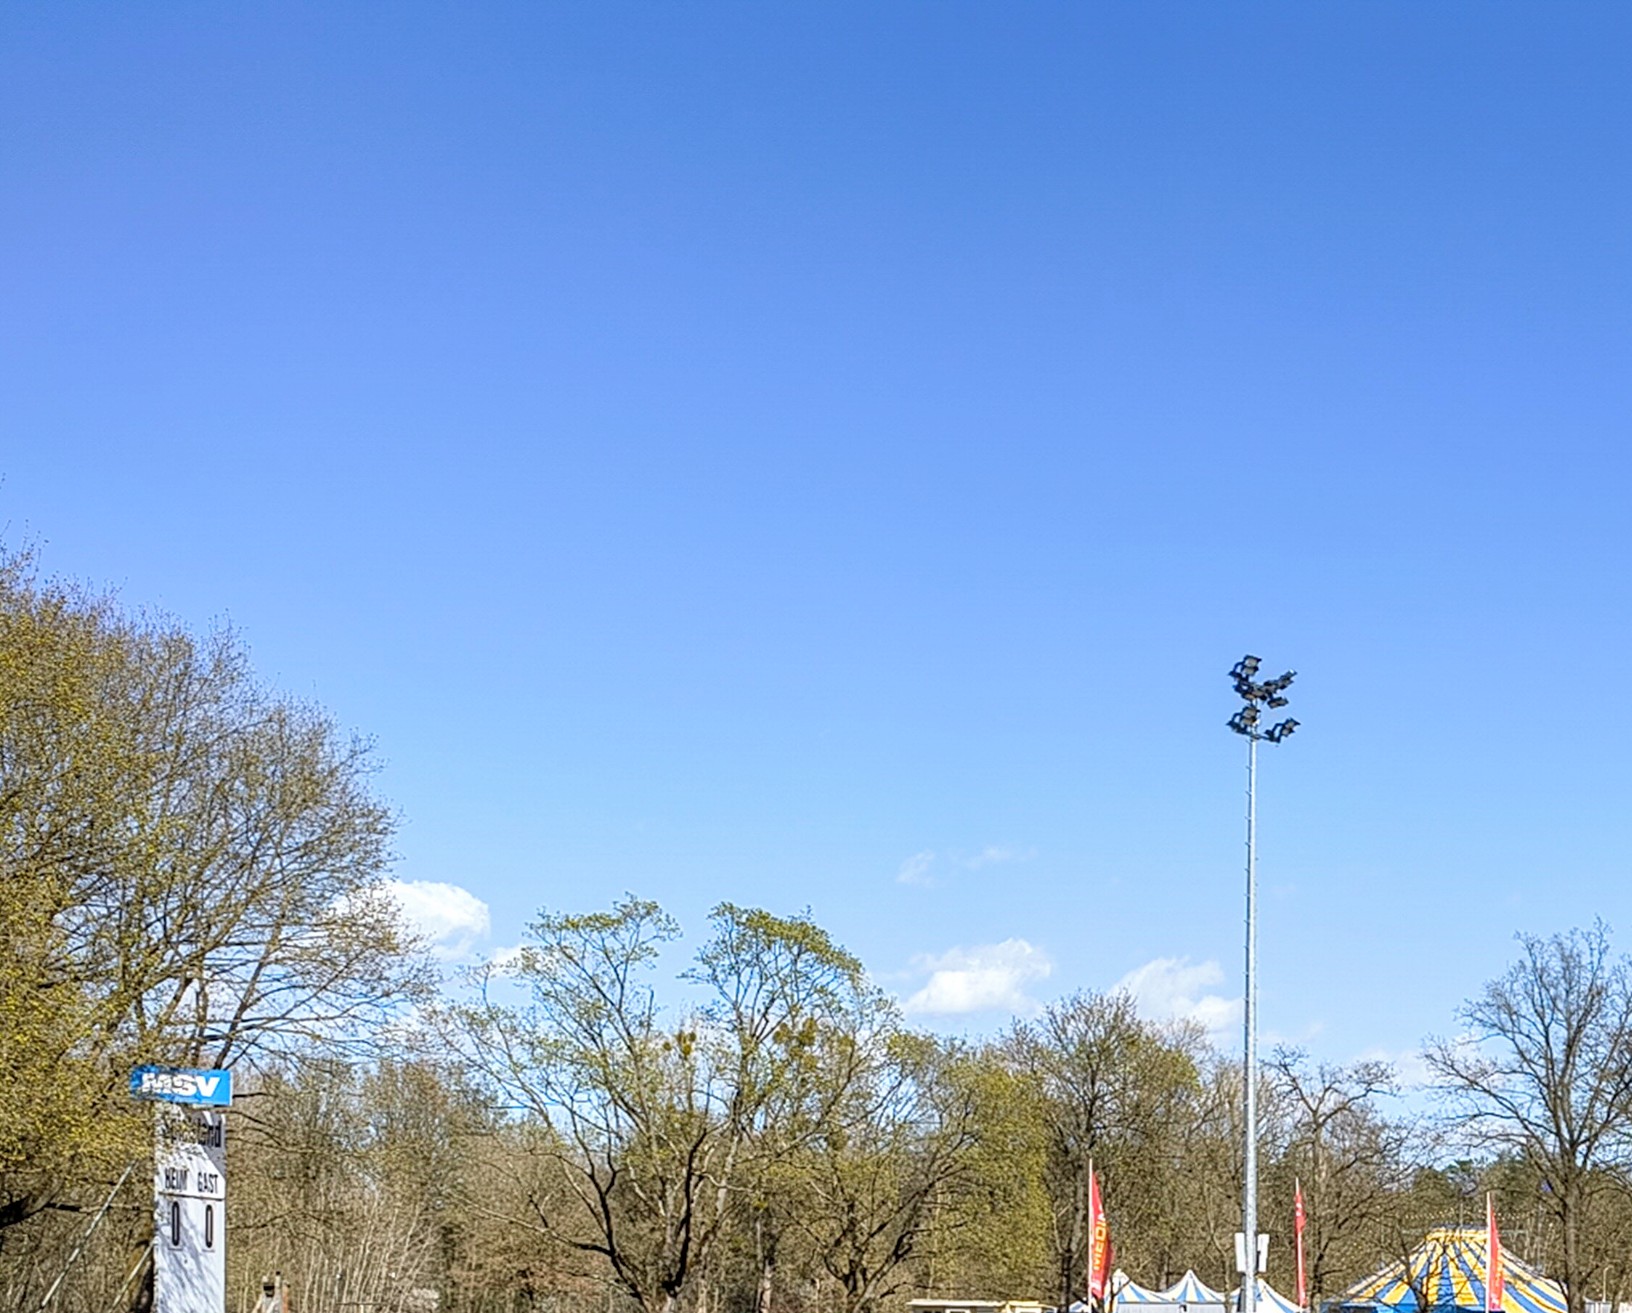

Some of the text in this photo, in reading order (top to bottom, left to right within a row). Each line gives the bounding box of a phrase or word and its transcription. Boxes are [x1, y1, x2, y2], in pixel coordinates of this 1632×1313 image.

[142, 1072, 219, 1097] MSV
[164, 1167, 218, 1194] HEIM GAST
